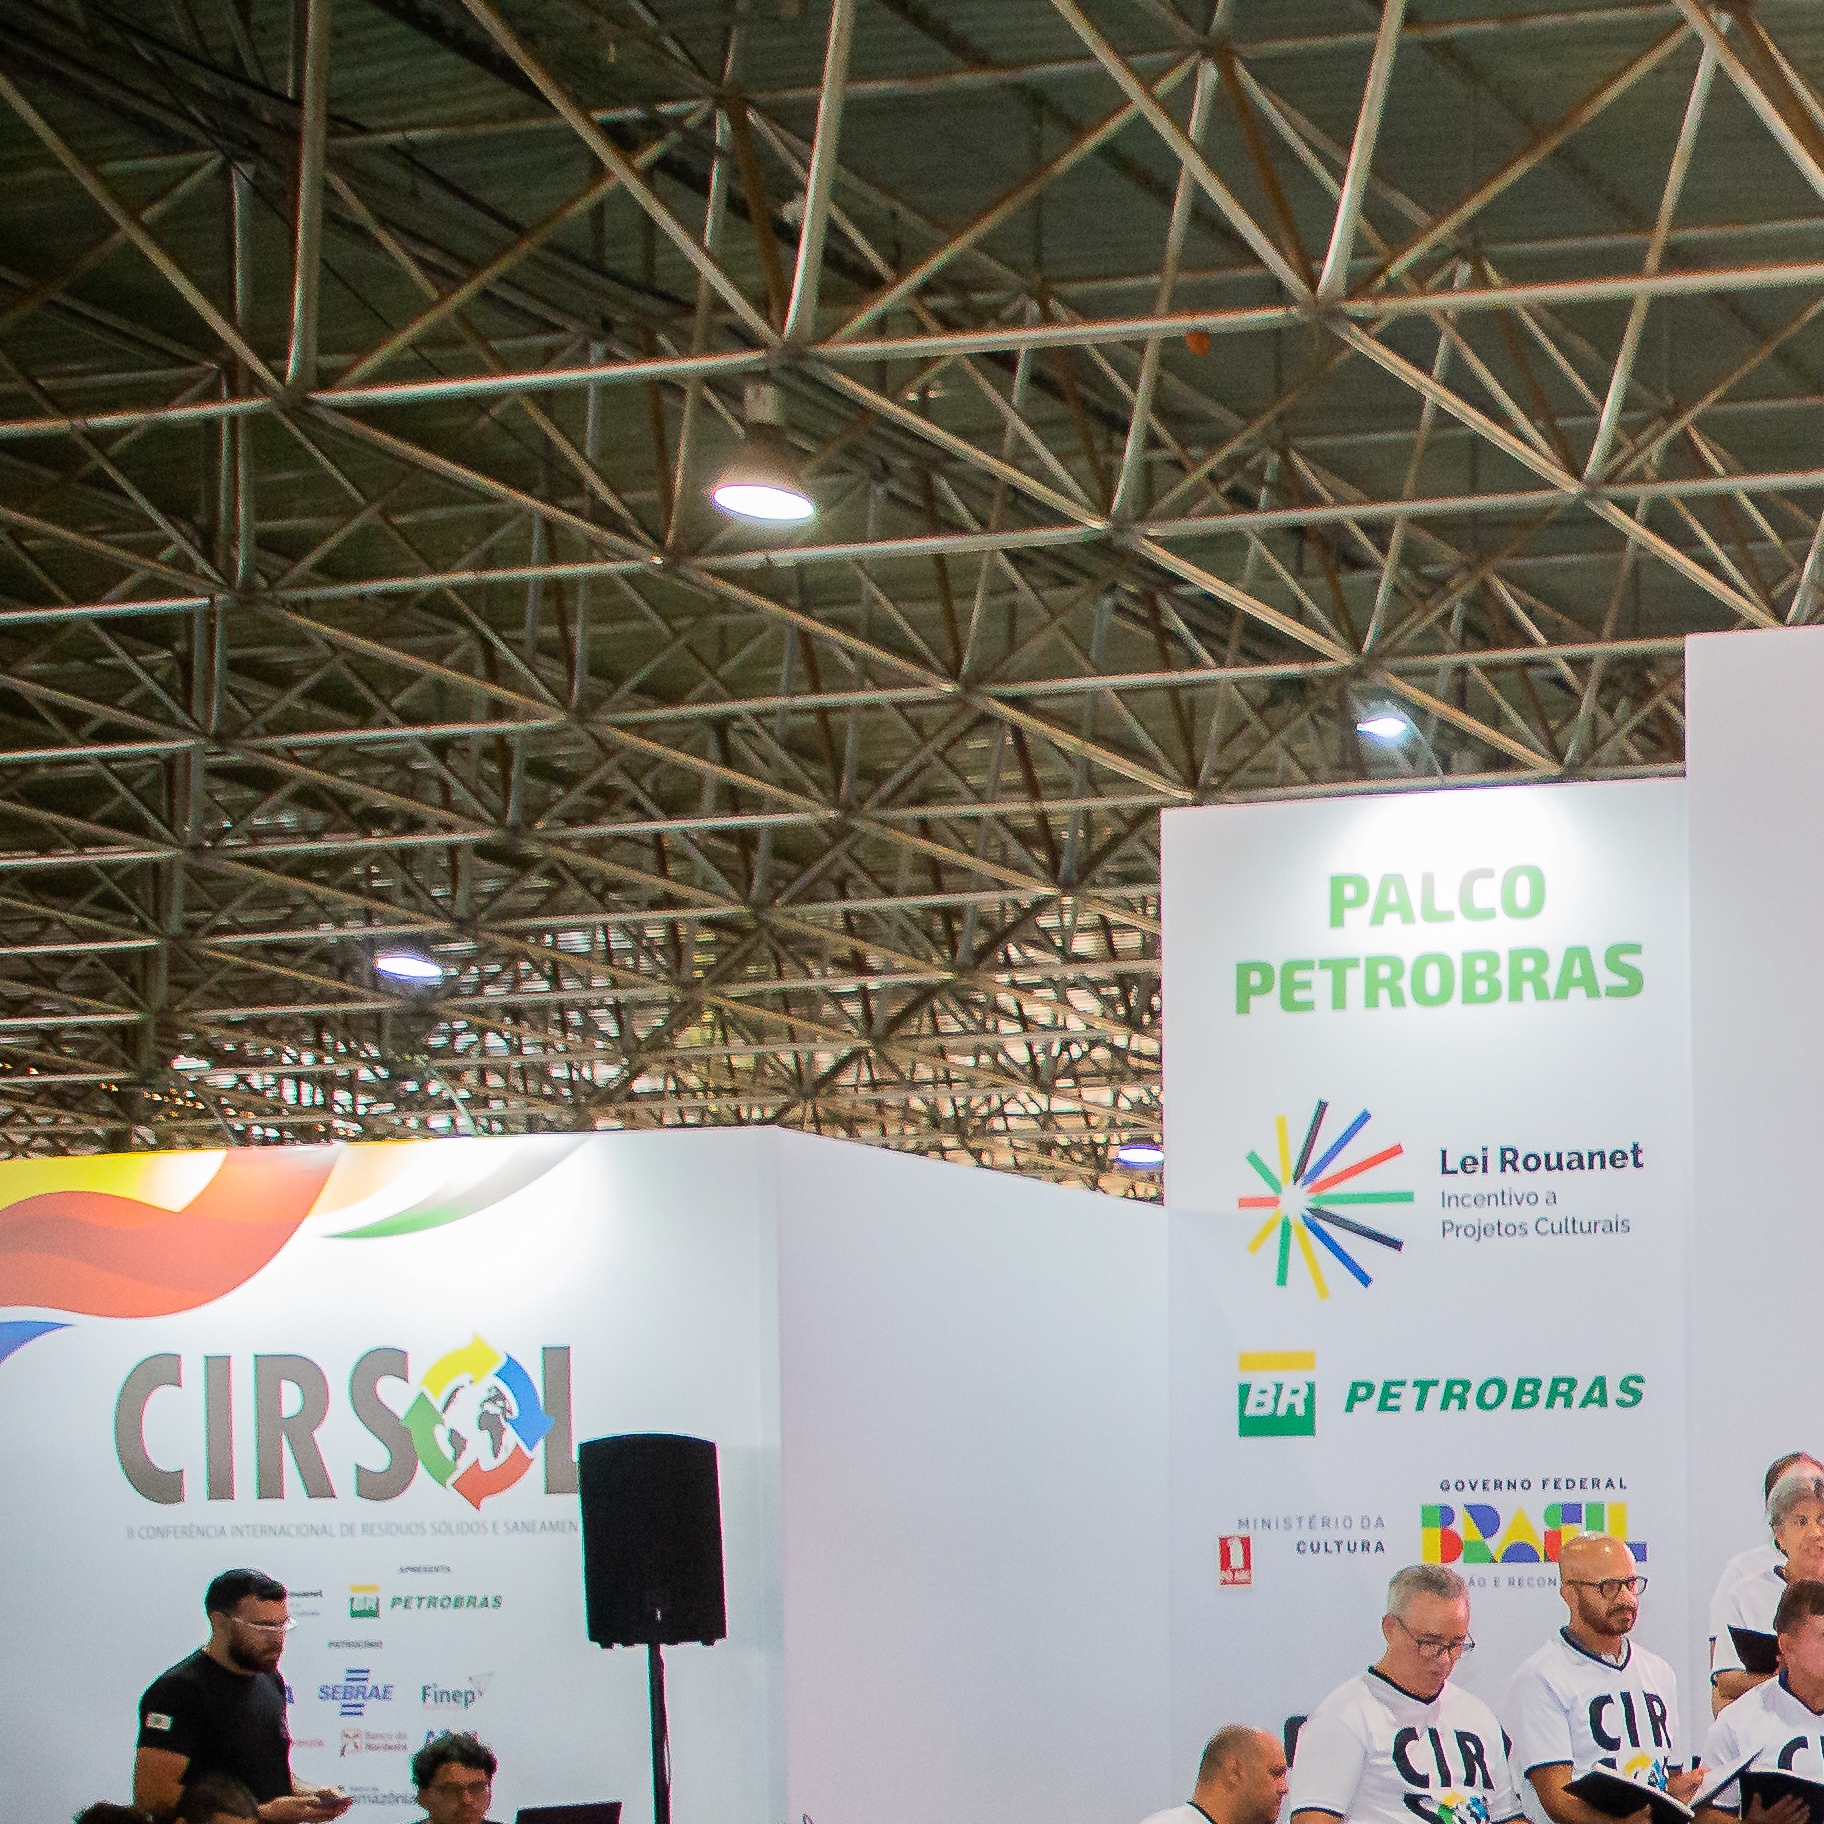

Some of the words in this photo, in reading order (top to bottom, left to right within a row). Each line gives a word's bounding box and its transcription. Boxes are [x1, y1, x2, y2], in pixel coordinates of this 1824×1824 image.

[1329, 865, 1547, 928] PALCO
[1235, 942, 1645, 1016] PETROBRAS
[1439, 1147, 1489, 1176] Lei
[1499, 1141, 1645, 1174] Rouanet
[1440, 1186, 1541, 1210] Incentivo
[1545, 1192, 1558, 1206] a
[1441, 1216, 1529, 1243] Projetos
[1534, 1214, 1632, 1237] Culturais
[1243, 1383, 1309, 1419] BR
[1344, 1374, 1646, 1413] PETROBRAS
[115, 1333, 577, 1510] CIRSOL
[1440, 1478, 1532, 1492] GOVERNO
[1541, 1477, 1628, 1491] FEDERAL
[137, 1522, 227, 1540] CONFERÊNCIA
[230, 1523, 336, 1538] INTERNACIONAL
[340, 1522, 357, 1538] DE
[361, 1520, 426, 1538] RESÍDUOS
[430, 1519, 489, 1537] SÓLIDOS
[492, 1521, 499, 1535] E
[504, 1519, 580, 1536] SANEAMEN
[1237, 1514, 1354, 1531] MINISTÉRIO
[1361, 1515, 1386, 1530] DA
[1296, 1539, 1386, 1554] CULTURA
[1494, 1576, 1500, 1588] E
[390, 1594, 504, 1611] PETROBRAS
[317, 1684, 395, 1701] SEBRAE
[421, 1684, 476, 1710] Finep
[1588, 1689, 1671, 1751] CIR
[1391, 1726, 1495, 1790] CIR
